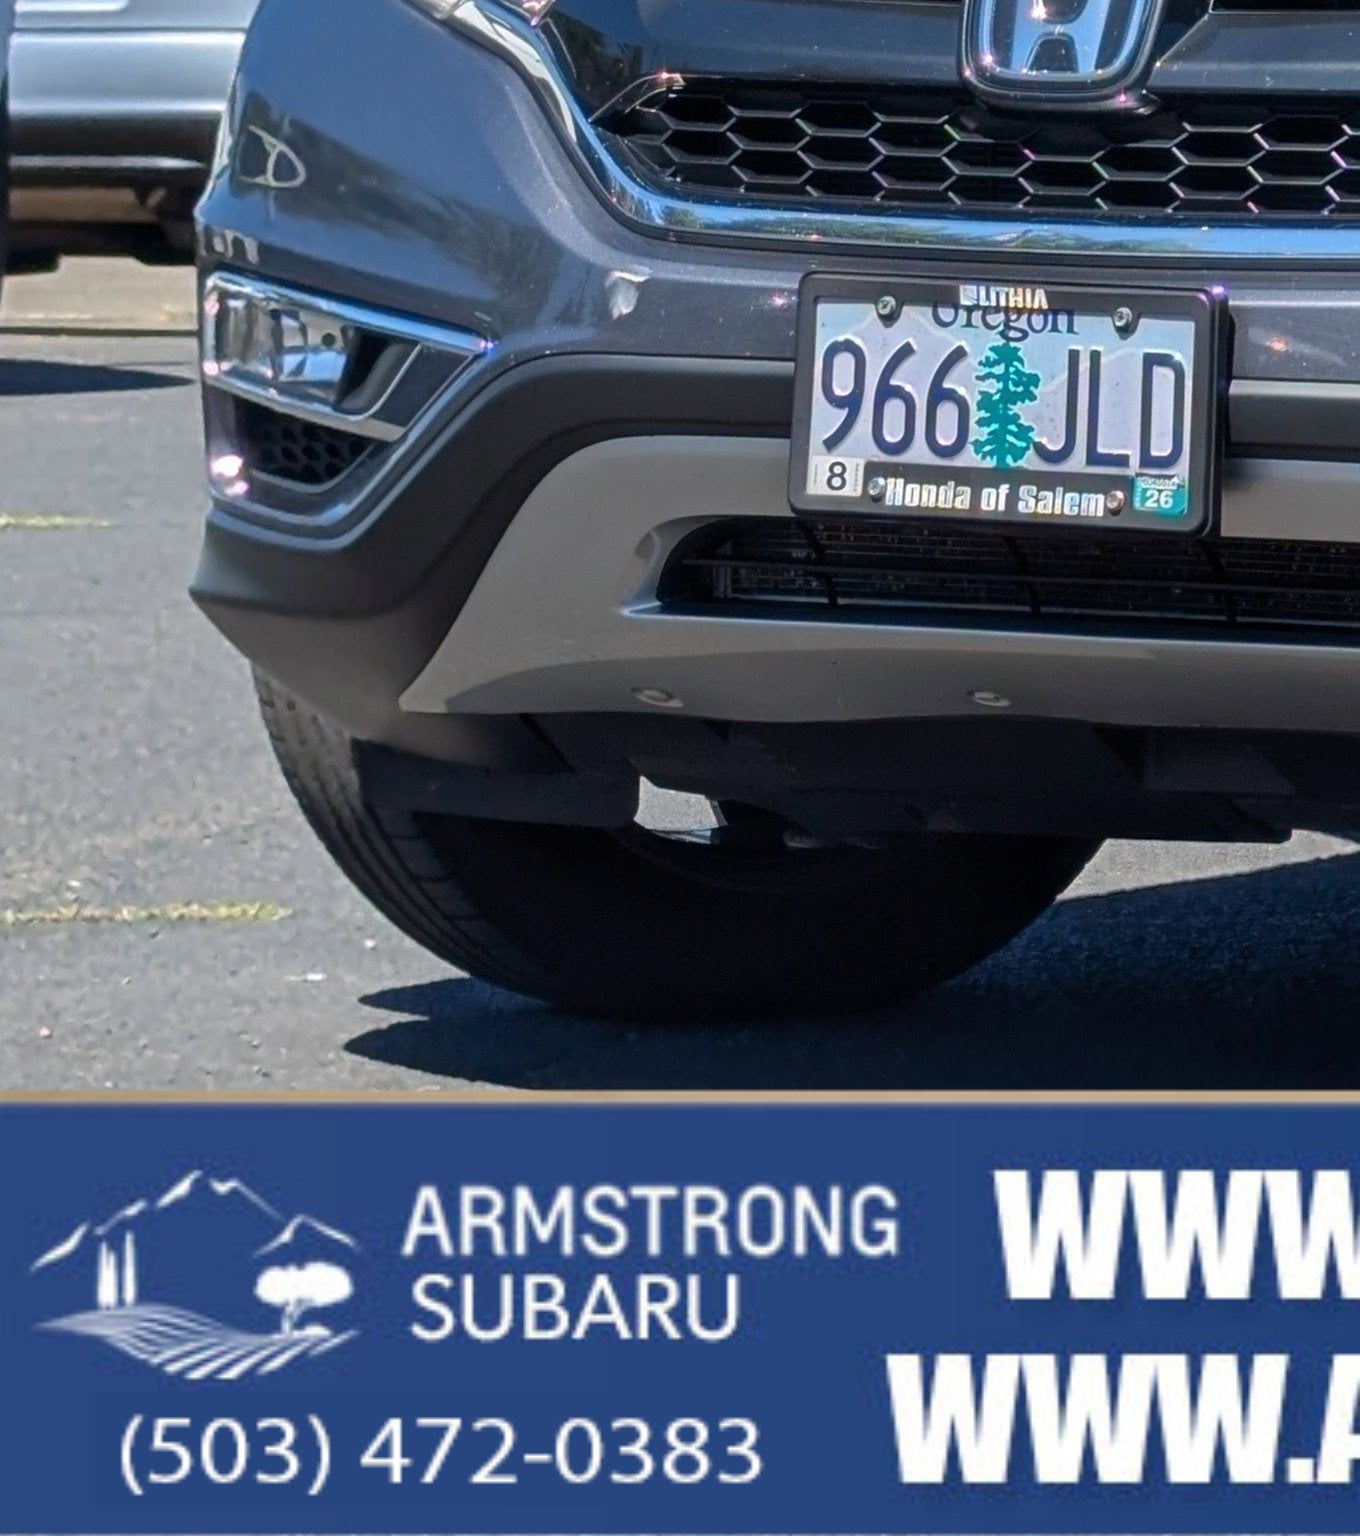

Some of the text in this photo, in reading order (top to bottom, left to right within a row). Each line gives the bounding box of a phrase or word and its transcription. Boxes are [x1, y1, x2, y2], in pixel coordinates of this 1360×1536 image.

[979, 285, 1049, 310] LITHIA
[932, 304, 1080, 343] Oregon
[821, 337, 1186, 472] 966 JLD
[826, 461, 848, 491] 8
[884, 477, 971, 510] Honda
[980, 484, 1009, 512] of
[1017, 484, 1105, 517] Salem
[1144, 489, 1174, 510] 26
